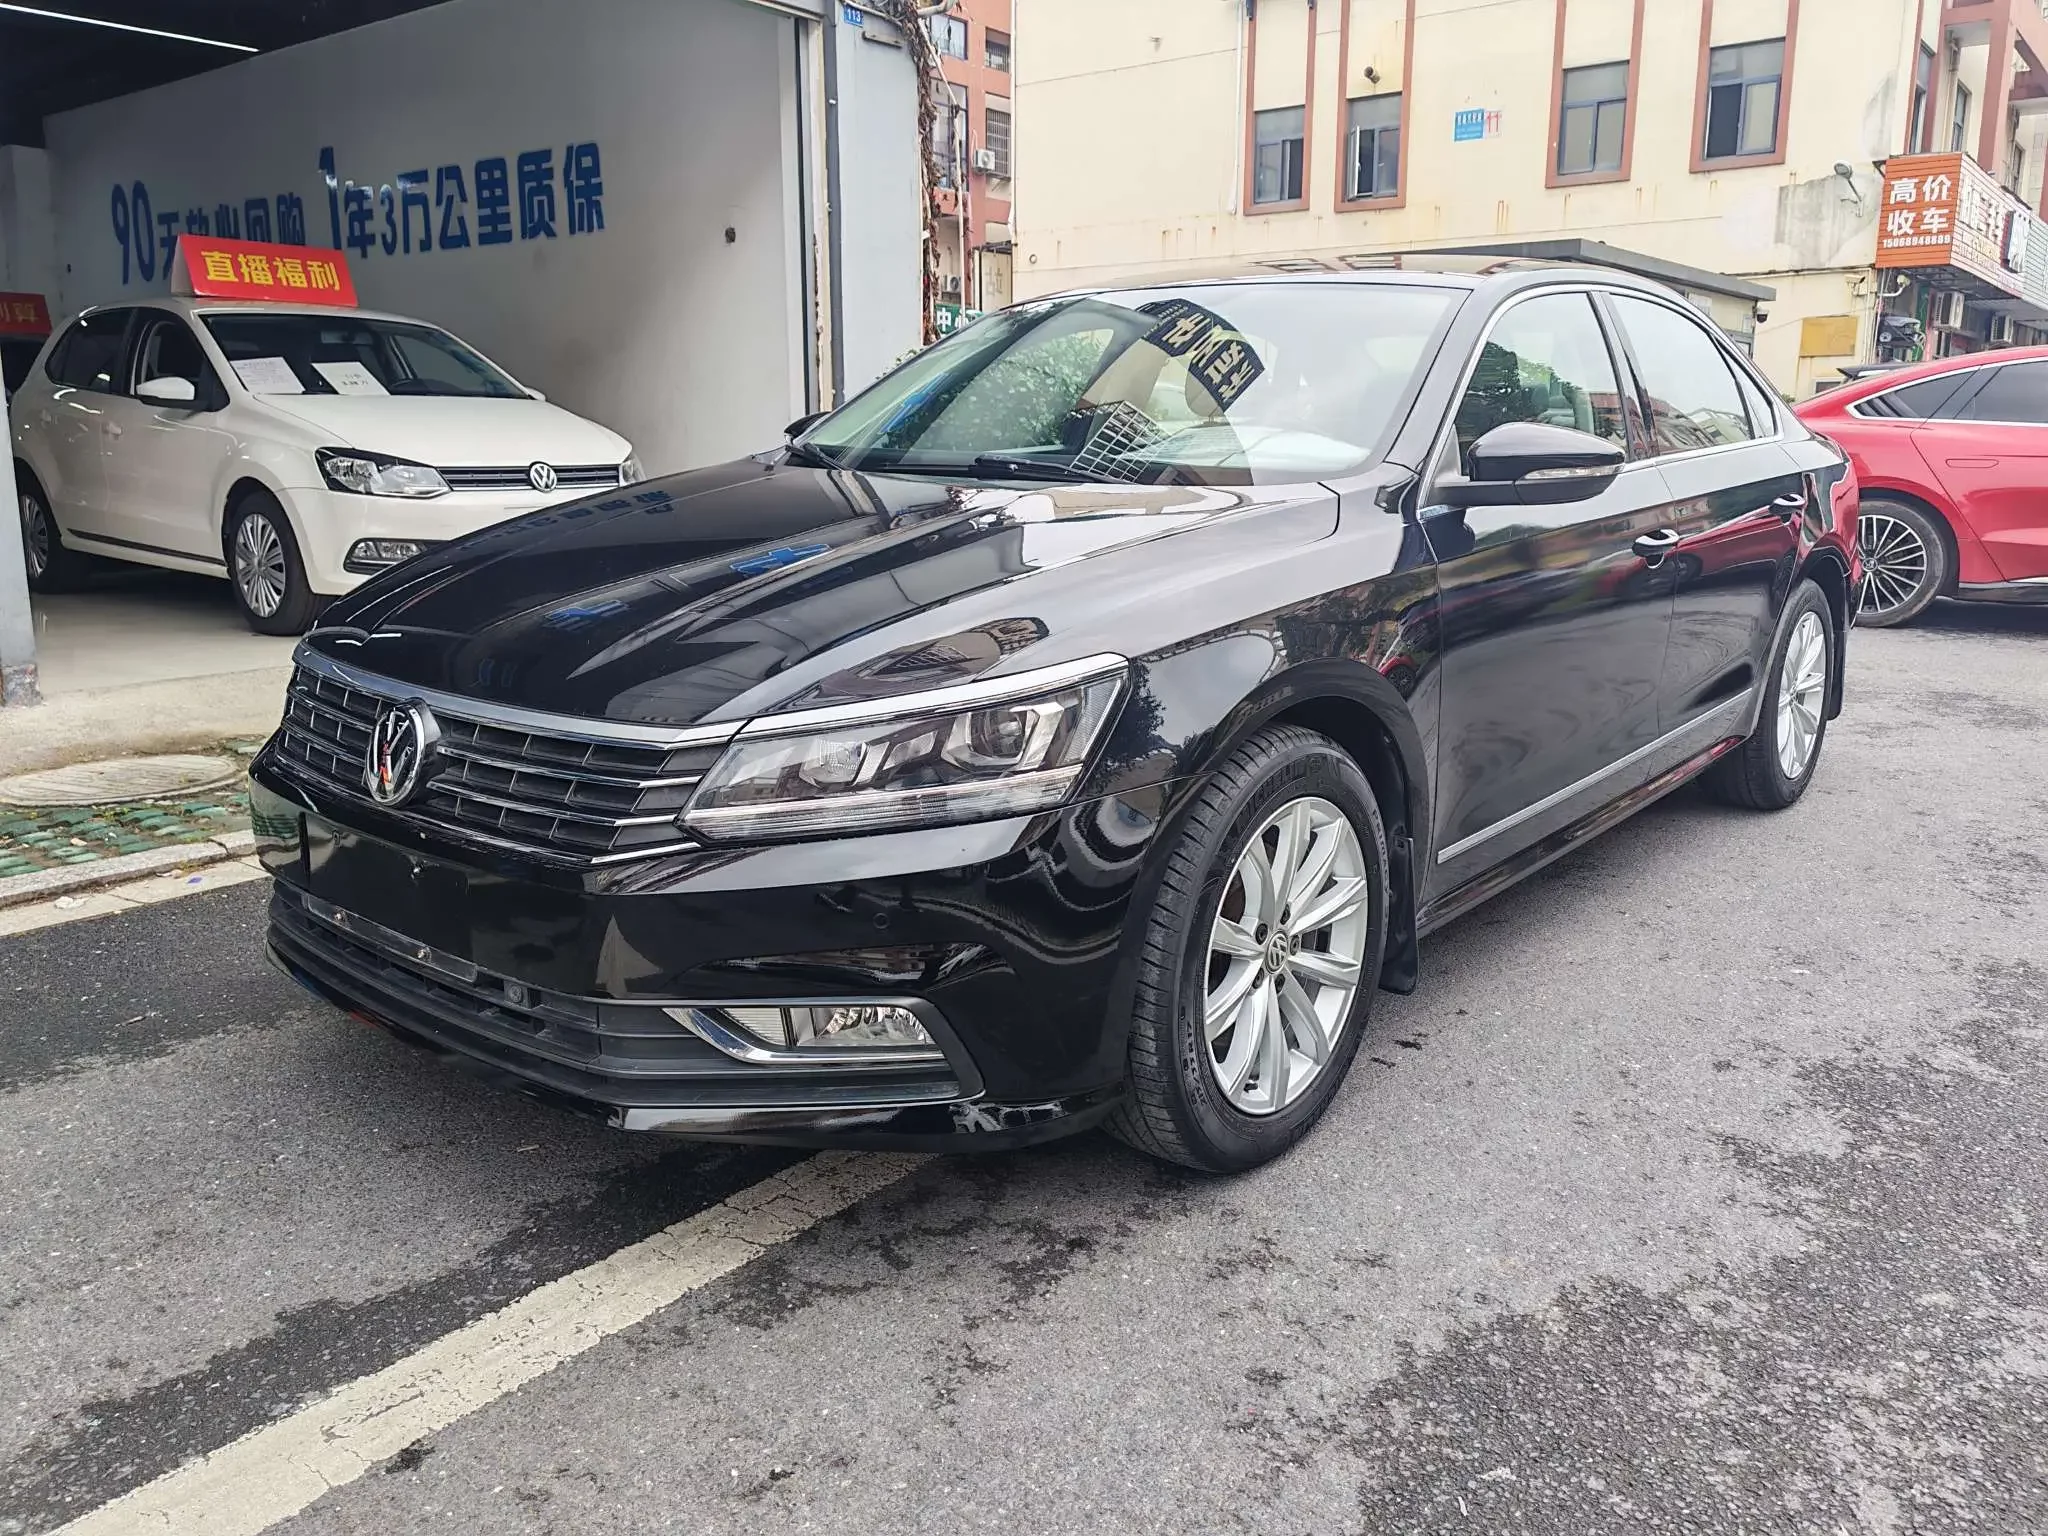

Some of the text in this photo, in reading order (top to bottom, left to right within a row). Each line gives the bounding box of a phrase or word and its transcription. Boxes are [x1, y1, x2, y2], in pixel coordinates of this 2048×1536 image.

[319, 142, 605, 259] 1年3万公里质保
[1889, 174, 1951, 204] 高价
[1887, 207, 1950, 236] 收车
[201, 251, 340, 291] 直播福利
